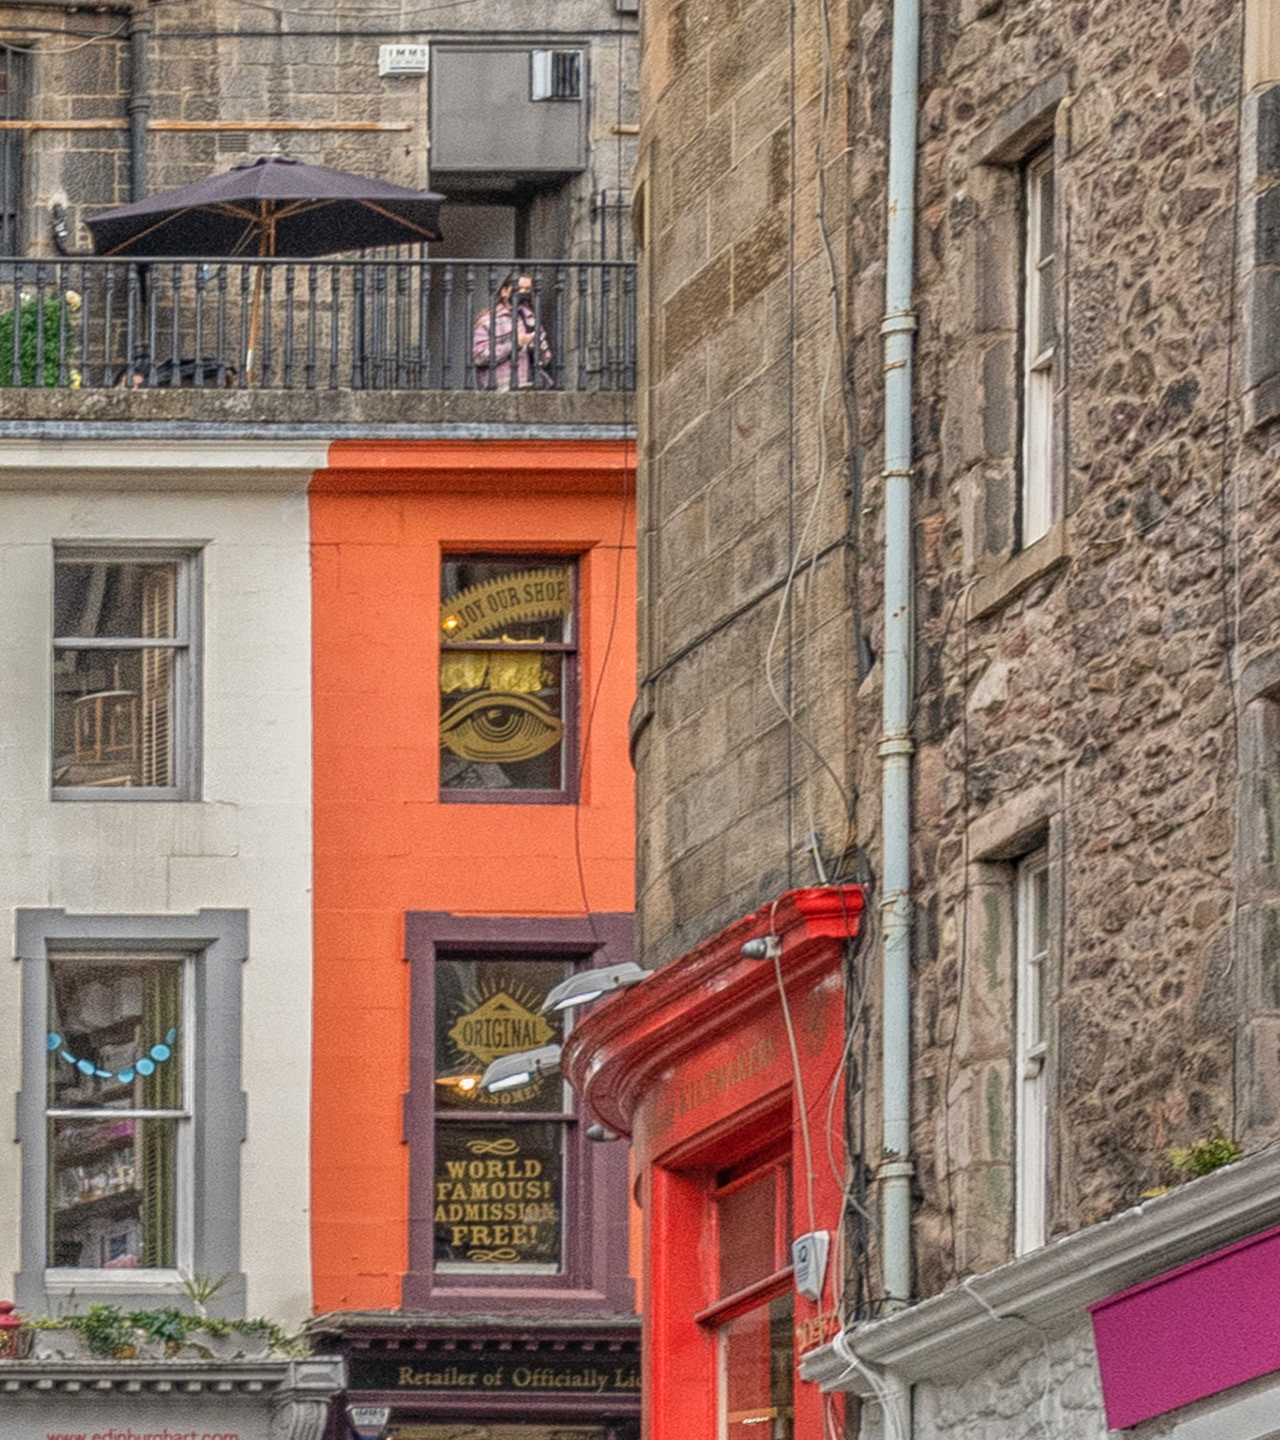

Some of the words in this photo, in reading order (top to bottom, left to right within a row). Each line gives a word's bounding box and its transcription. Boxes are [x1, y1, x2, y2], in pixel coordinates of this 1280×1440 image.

[486, 586, 521, 612] OUR
[462, 1017, 541, 1048] ORIGINAL
[445, 1159, 542, 1179] WORLD
[436, 1180, 552, 1201] FAMOUS!
[434, 1201, 558, 1223] ADMISSION
[450, 1224, 539, 1247] FREE!
[397, 1366, 478, 1386] Retailer
[482, 1367, 504, 1386] of
[512, 1368, 609, 1394] Officially
